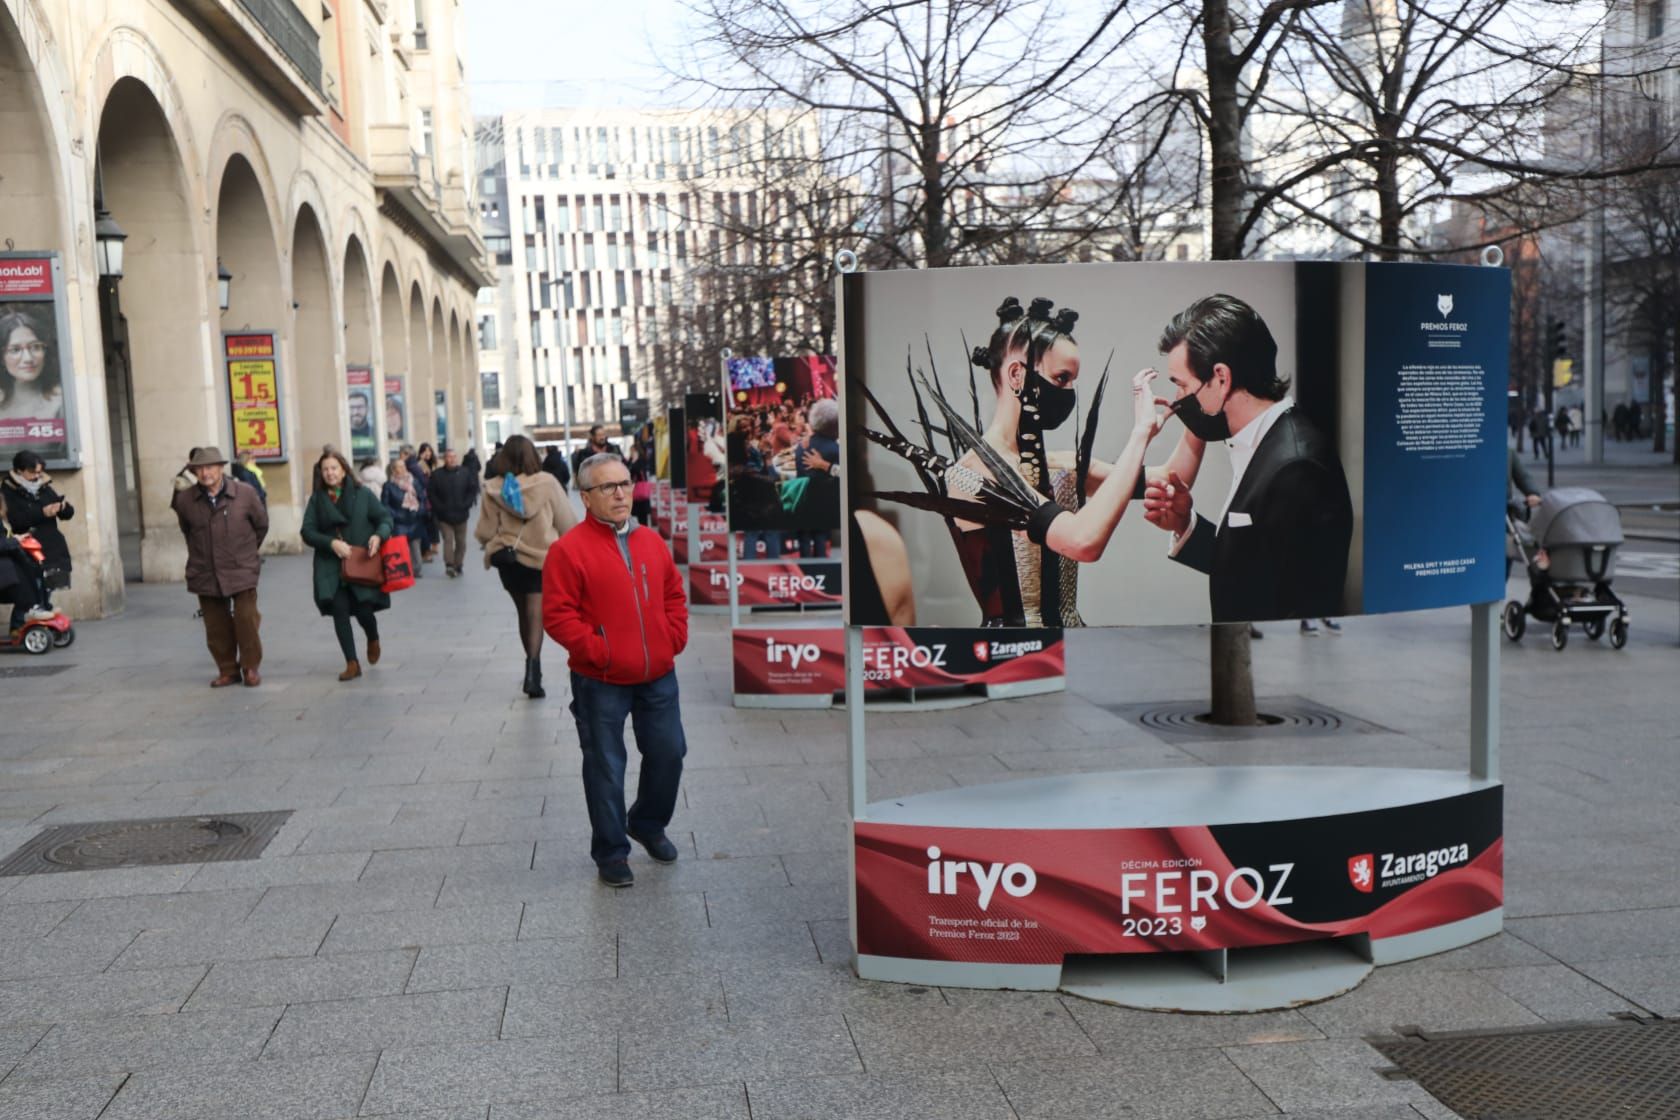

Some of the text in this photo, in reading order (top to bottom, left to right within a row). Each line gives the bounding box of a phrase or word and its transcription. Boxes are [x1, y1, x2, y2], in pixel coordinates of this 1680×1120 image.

[1420, 322, 1468, 331] PREMIOS FEROZ
[248, 419, 267, 446] 3
[1415, 568, 1440, 577] PREMIOS
[768, 575, 826, 592] FEROZ
[766, 637, 821, 670] iryo
[862, 644, 947, 670] FEROZ
[991, 640, 1043, 657] Zaragoza
[863, 669, 892, 681] 2023
[1121, 858, 1203, 870] DÉCIMA EDICIÓN
[1380, 842, 1470, 878] Zaragoza
[927, 845, 1038, 912] iryo
[1381, 873, 1426, 888] AYUNTAMIENTO
[1121, 862, 1296, 915] FEROZ
[928, 916, 1039, 929] Transporte oficial de los
[1122, 917, 1183, 937] 2023
[929, 927, 1021, 941] Premios Feroz 2023
